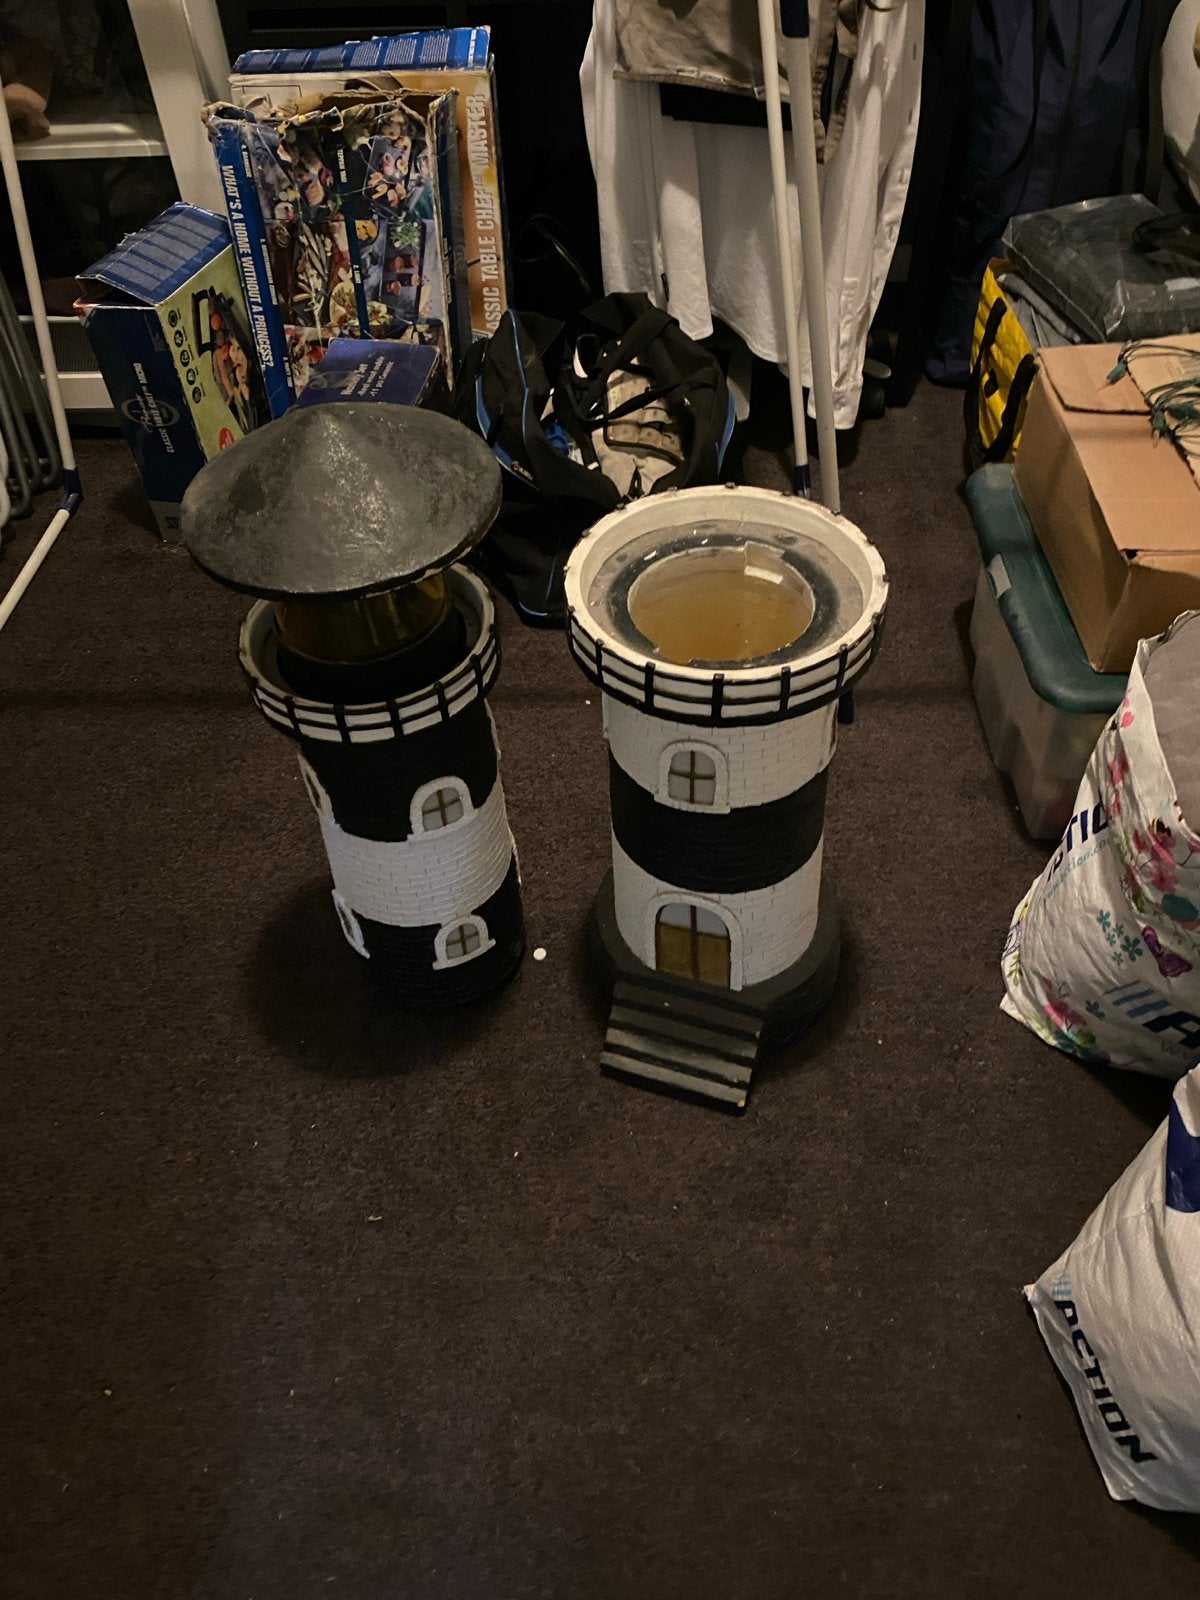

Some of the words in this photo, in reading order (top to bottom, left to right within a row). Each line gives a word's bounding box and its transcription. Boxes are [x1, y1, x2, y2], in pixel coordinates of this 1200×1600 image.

[466, 94, 488, 166] MASTER
[222, 164, 242, 210] WHAT'S
[234, 222, 252, 254] HOME
[479, 236, 498, 281] TABLE
[241, 256, 262, 303] WITHOUT
[252, 304, 264, 312] A
[482, 286, 501, 335] ASSIC
[253, 314, 275, 367] PRINCESS?
[133, 363, 148, 384] MICRO
[159, 427, 175, 453] CLASSIC
[1054, 1300, 1158, 1463] ACTION
